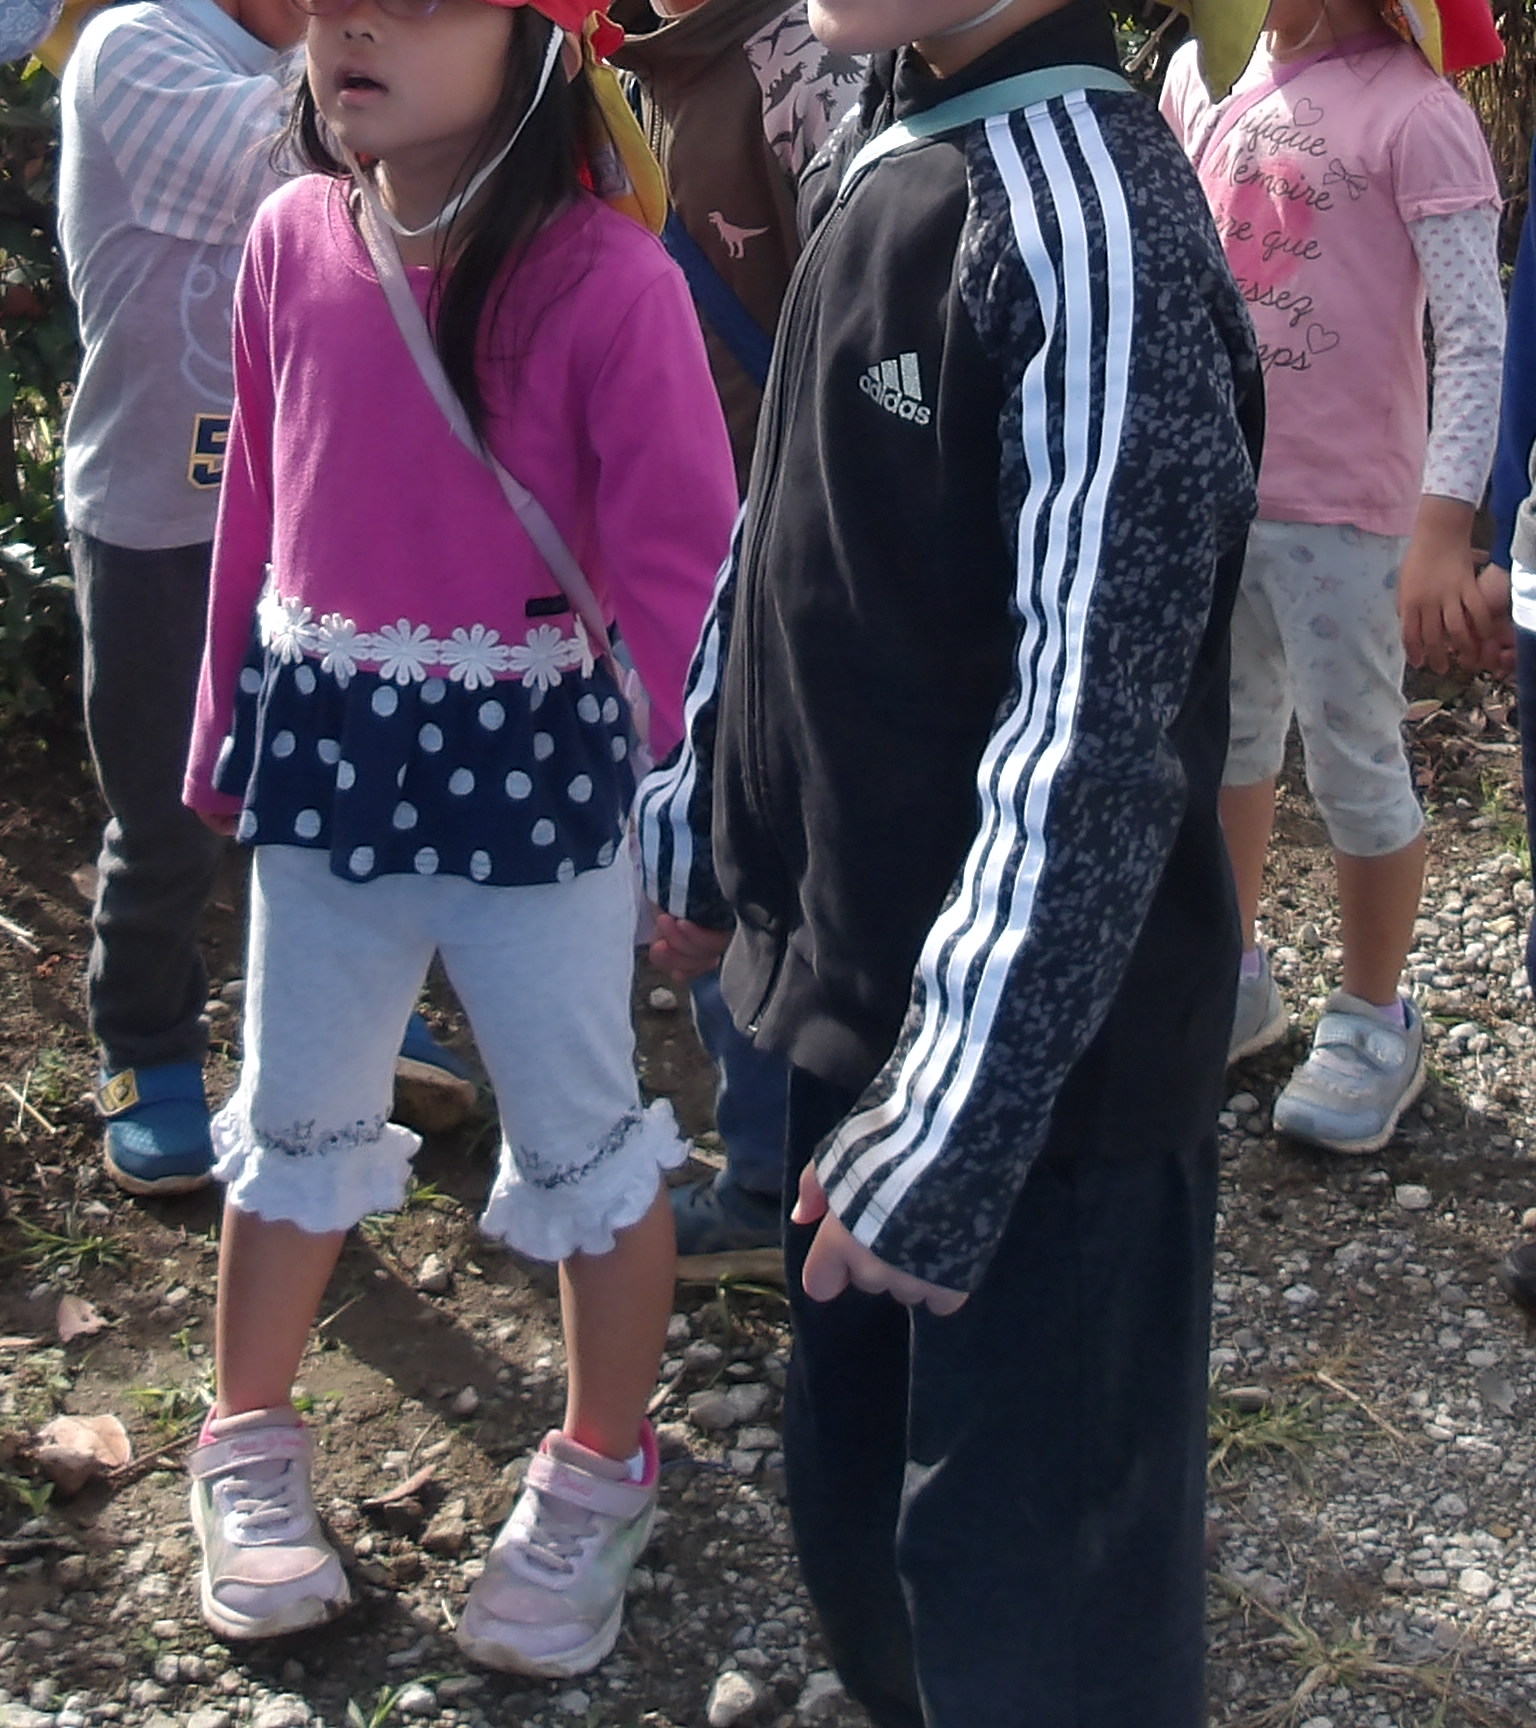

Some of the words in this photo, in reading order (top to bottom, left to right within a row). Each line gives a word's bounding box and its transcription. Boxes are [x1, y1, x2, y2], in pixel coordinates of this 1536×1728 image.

[1239, 108, 1327, 158] ifique
[1210, 145, 1333, 211] Mémoire
[1262, 230, 1322, 262] que
[858, 374, 932, 426] adidas
